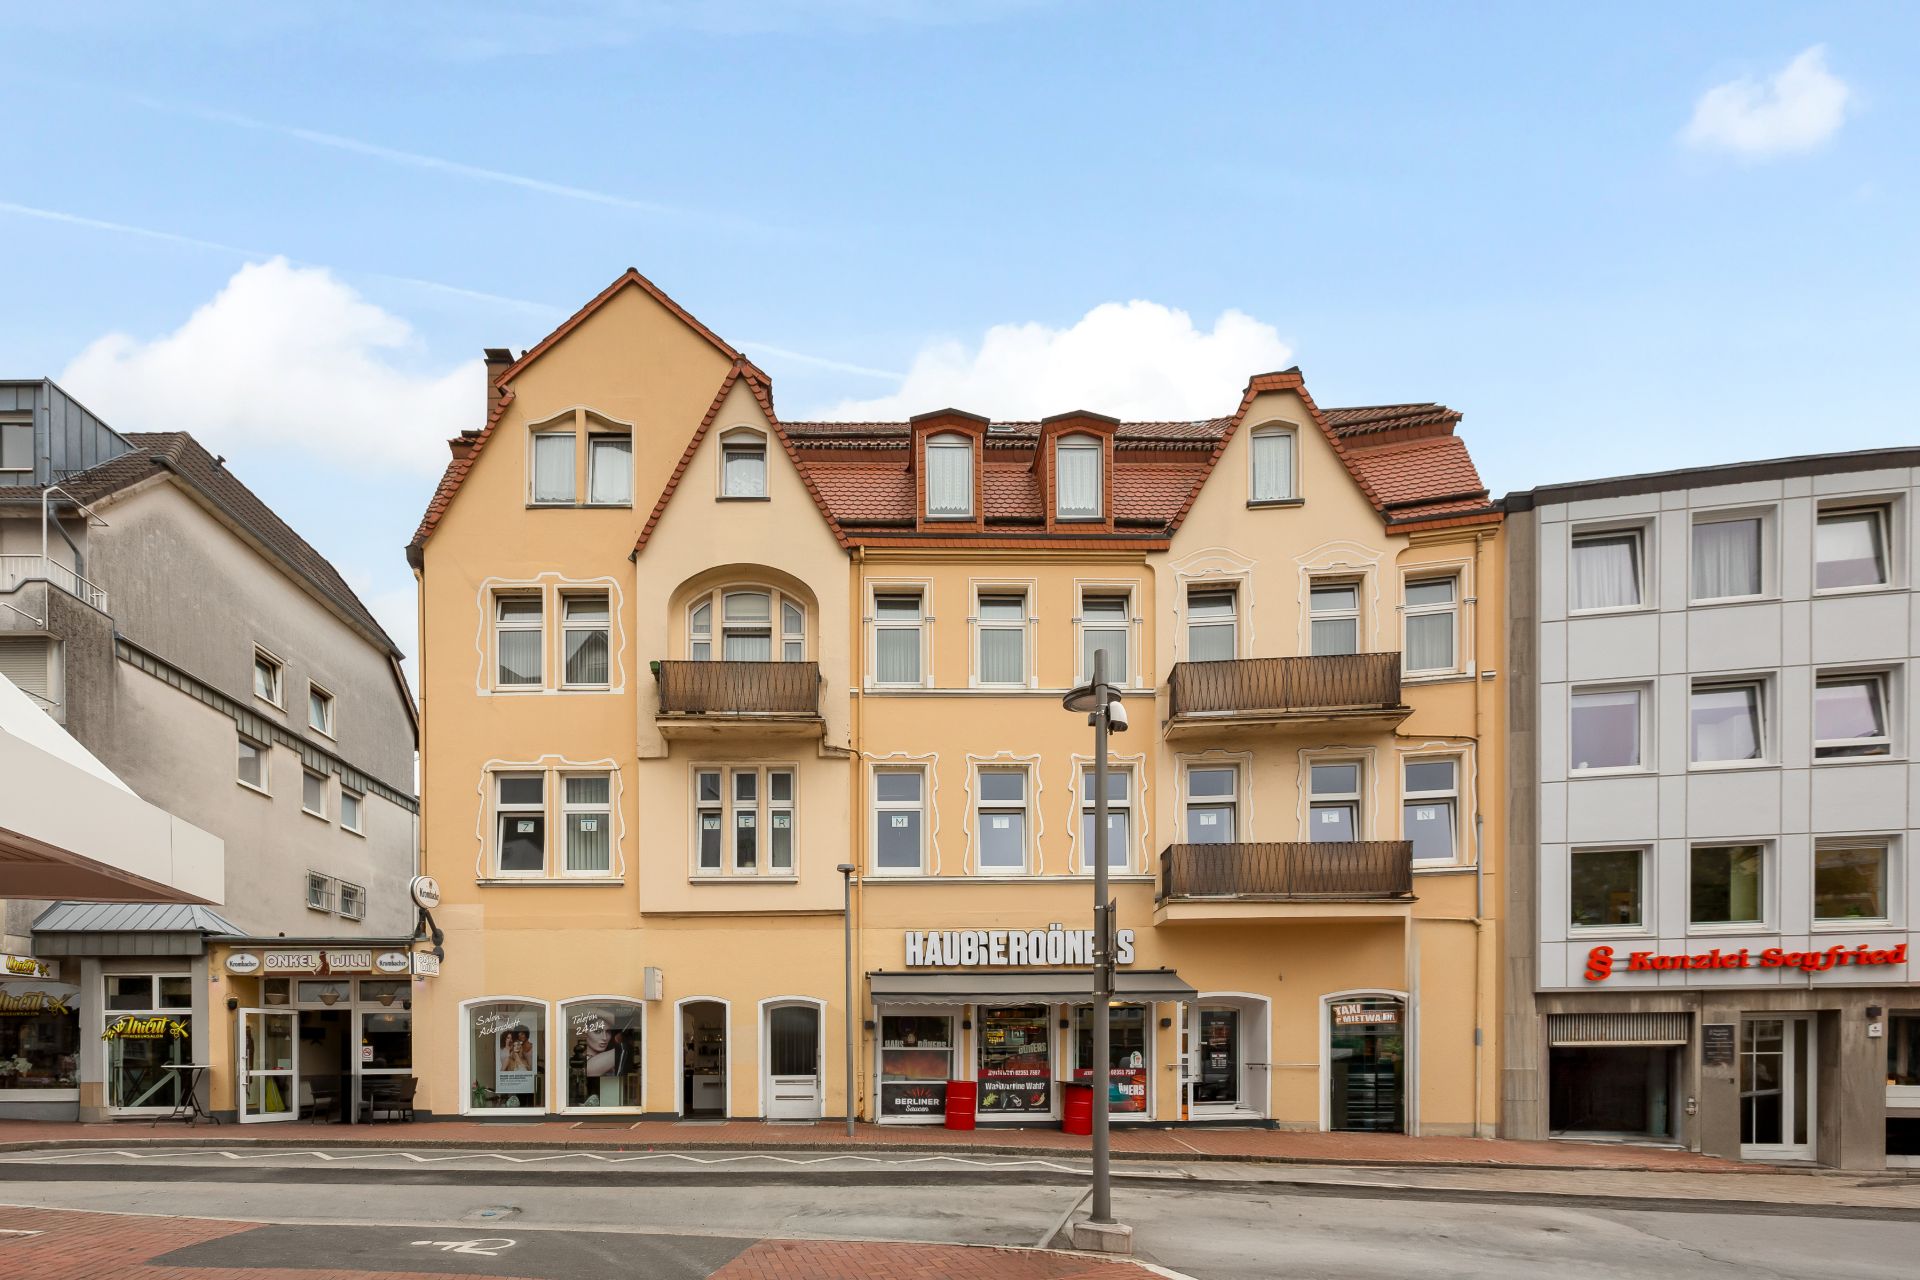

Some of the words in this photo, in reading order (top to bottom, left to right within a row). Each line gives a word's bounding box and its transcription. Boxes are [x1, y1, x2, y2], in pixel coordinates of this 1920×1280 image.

[229, 960, 257, 968] Krombacher
[266, 954, 316, 968] ONKEL
[330, 953, 370, 967] WILLI
[1627, 948, 1750, 971] Kanzlei
[1759, 943, 1908, 971] Seyfried
[1333, 1004, 1361, 1015] TAXI
[475, 1011, 501, 1026] Salon
[572, 1011, 598, 1025] Telefon
[1026, 1082, 1045, 1090] Wahl?
